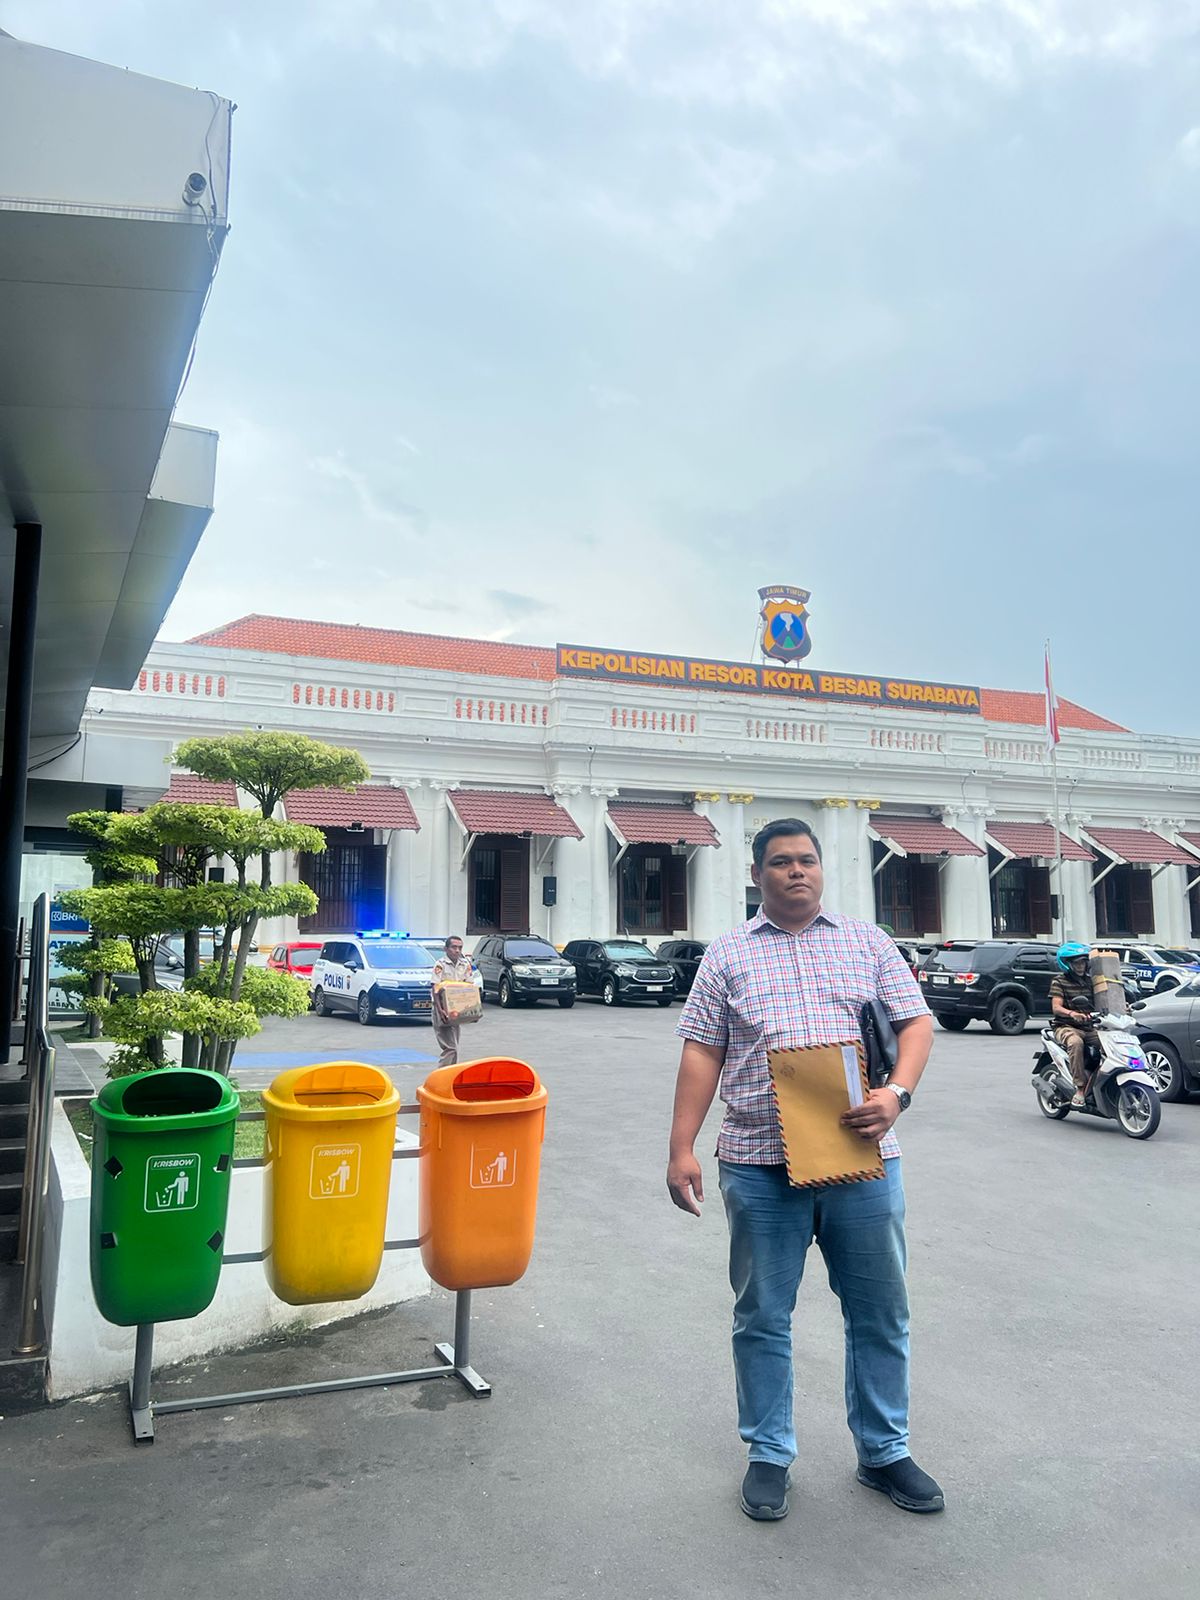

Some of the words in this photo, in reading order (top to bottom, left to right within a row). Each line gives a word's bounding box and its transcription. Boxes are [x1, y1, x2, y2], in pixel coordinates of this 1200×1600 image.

[767, 587, 784, 595] JAWA
[786, 587, 808, 599] TIMUR
[560, 648, 685, 680] KEPOLISIAN
[689, 662, 757, 687] RESOR
[761, 669, 815, 692] KOTA
[818, 675, 882, 699] BESAR
[887, 682, 980, 707] SURABAYA
[323, 973, 344, 990] POLISI
[153, 1159, 194, 1168] KRISBOW
